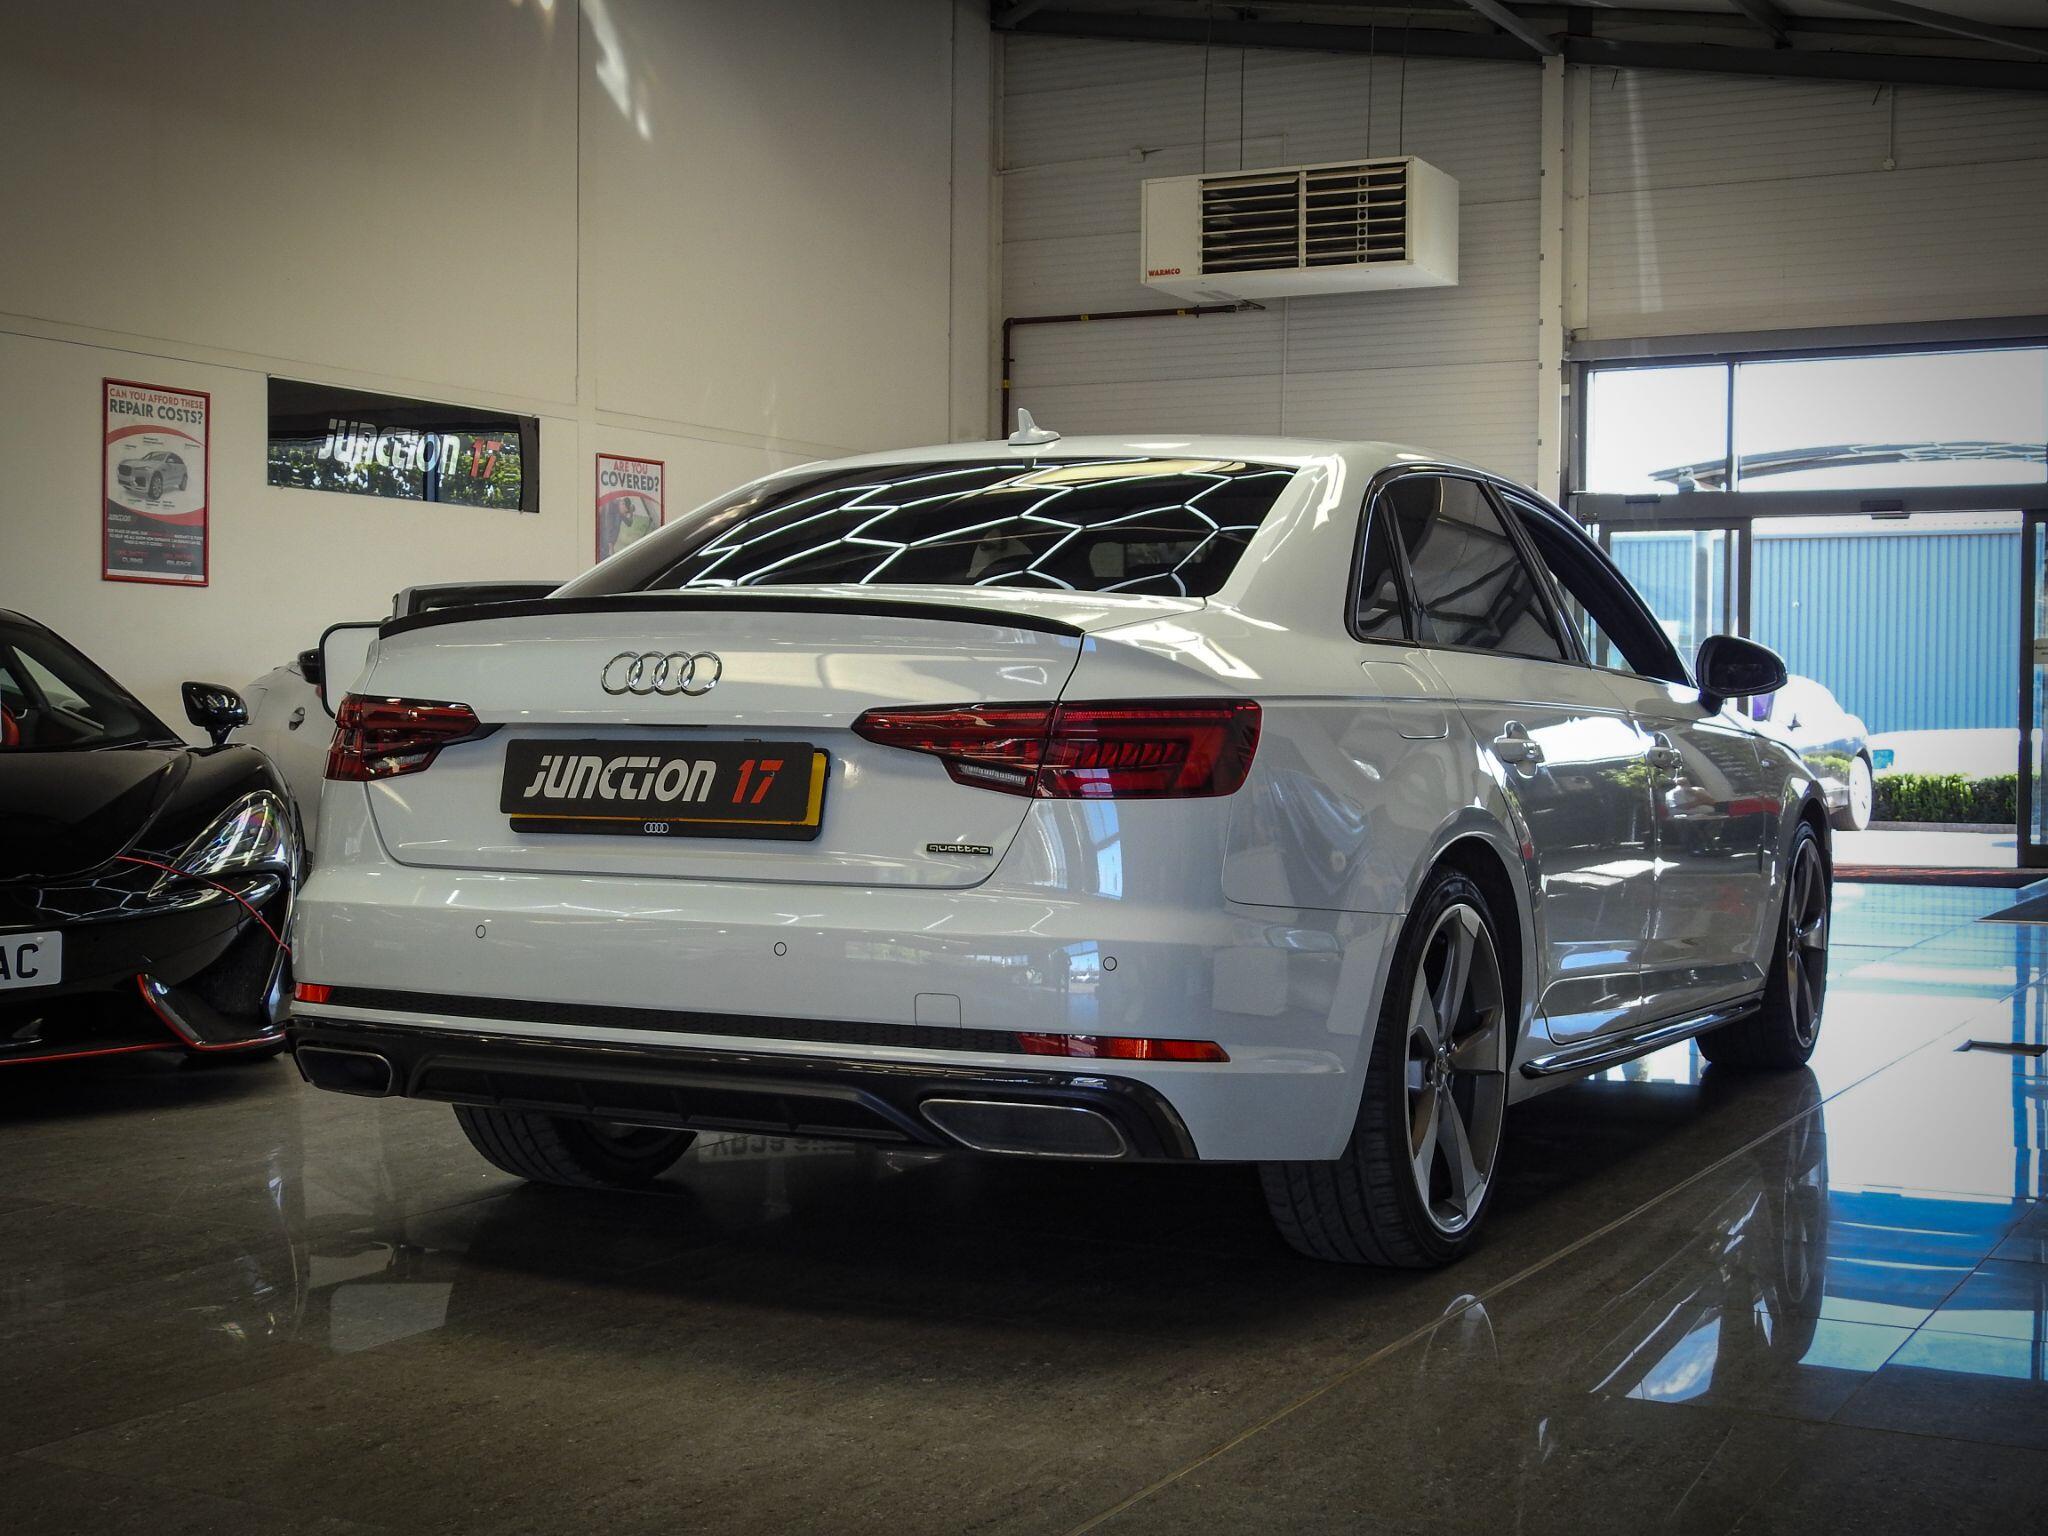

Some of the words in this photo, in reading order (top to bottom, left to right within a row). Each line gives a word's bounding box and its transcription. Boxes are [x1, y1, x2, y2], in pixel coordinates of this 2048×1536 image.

[1148, 268, 1181, 277] WARMCO
[109, 388, 127, 398] CAN
[129, 390, 146, 401] YOU
[148, 394, 179, 406] AFFORD
[180, 398, 204, 410] THESE
[109, 398, 154, 418] REPAIR
[157, 405, 203, 425] COSTS?
[470, 436, 504, 479] 17
[613, 460, 629, 473] ARE
[631, 462, 648, 475] YOU
[600, 470, 660, 492] COVERED?
[731, 759, 784, 804] 17
[929, 844, 989, 853] quattro
